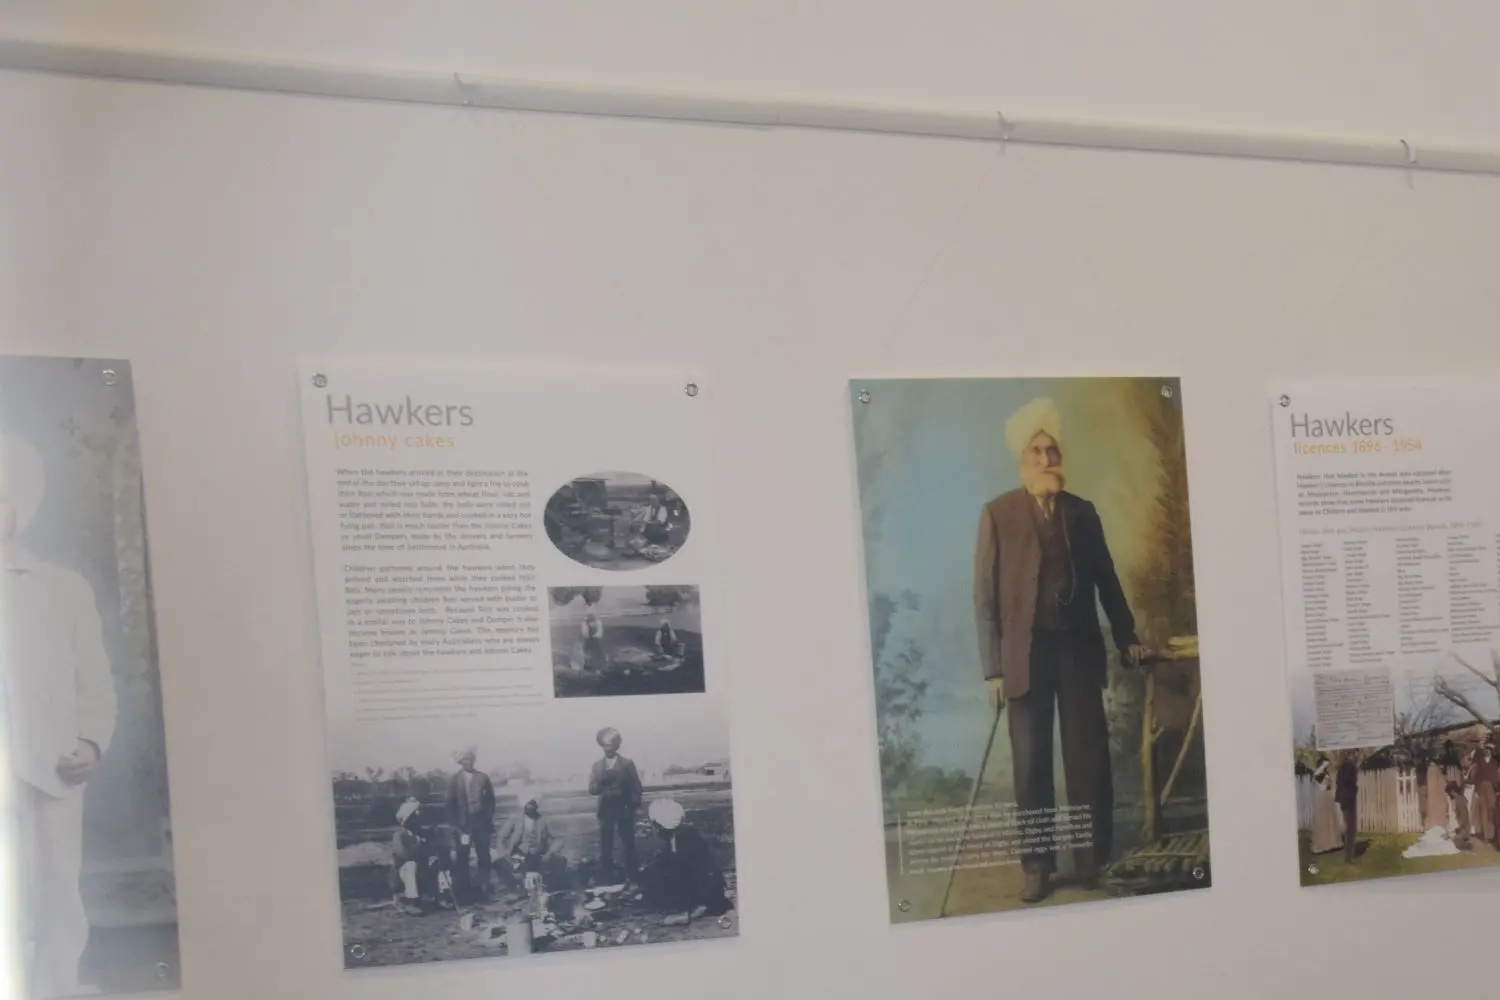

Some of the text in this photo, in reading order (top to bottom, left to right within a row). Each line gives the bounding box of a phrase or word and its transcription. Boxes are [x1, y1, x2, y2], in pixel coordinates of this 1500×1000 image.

[326, 393, 475, 428] Hawkers
[1290, 411, 1394, 438] Hawkers
[334, 431, 456, 451] johnny cakes
